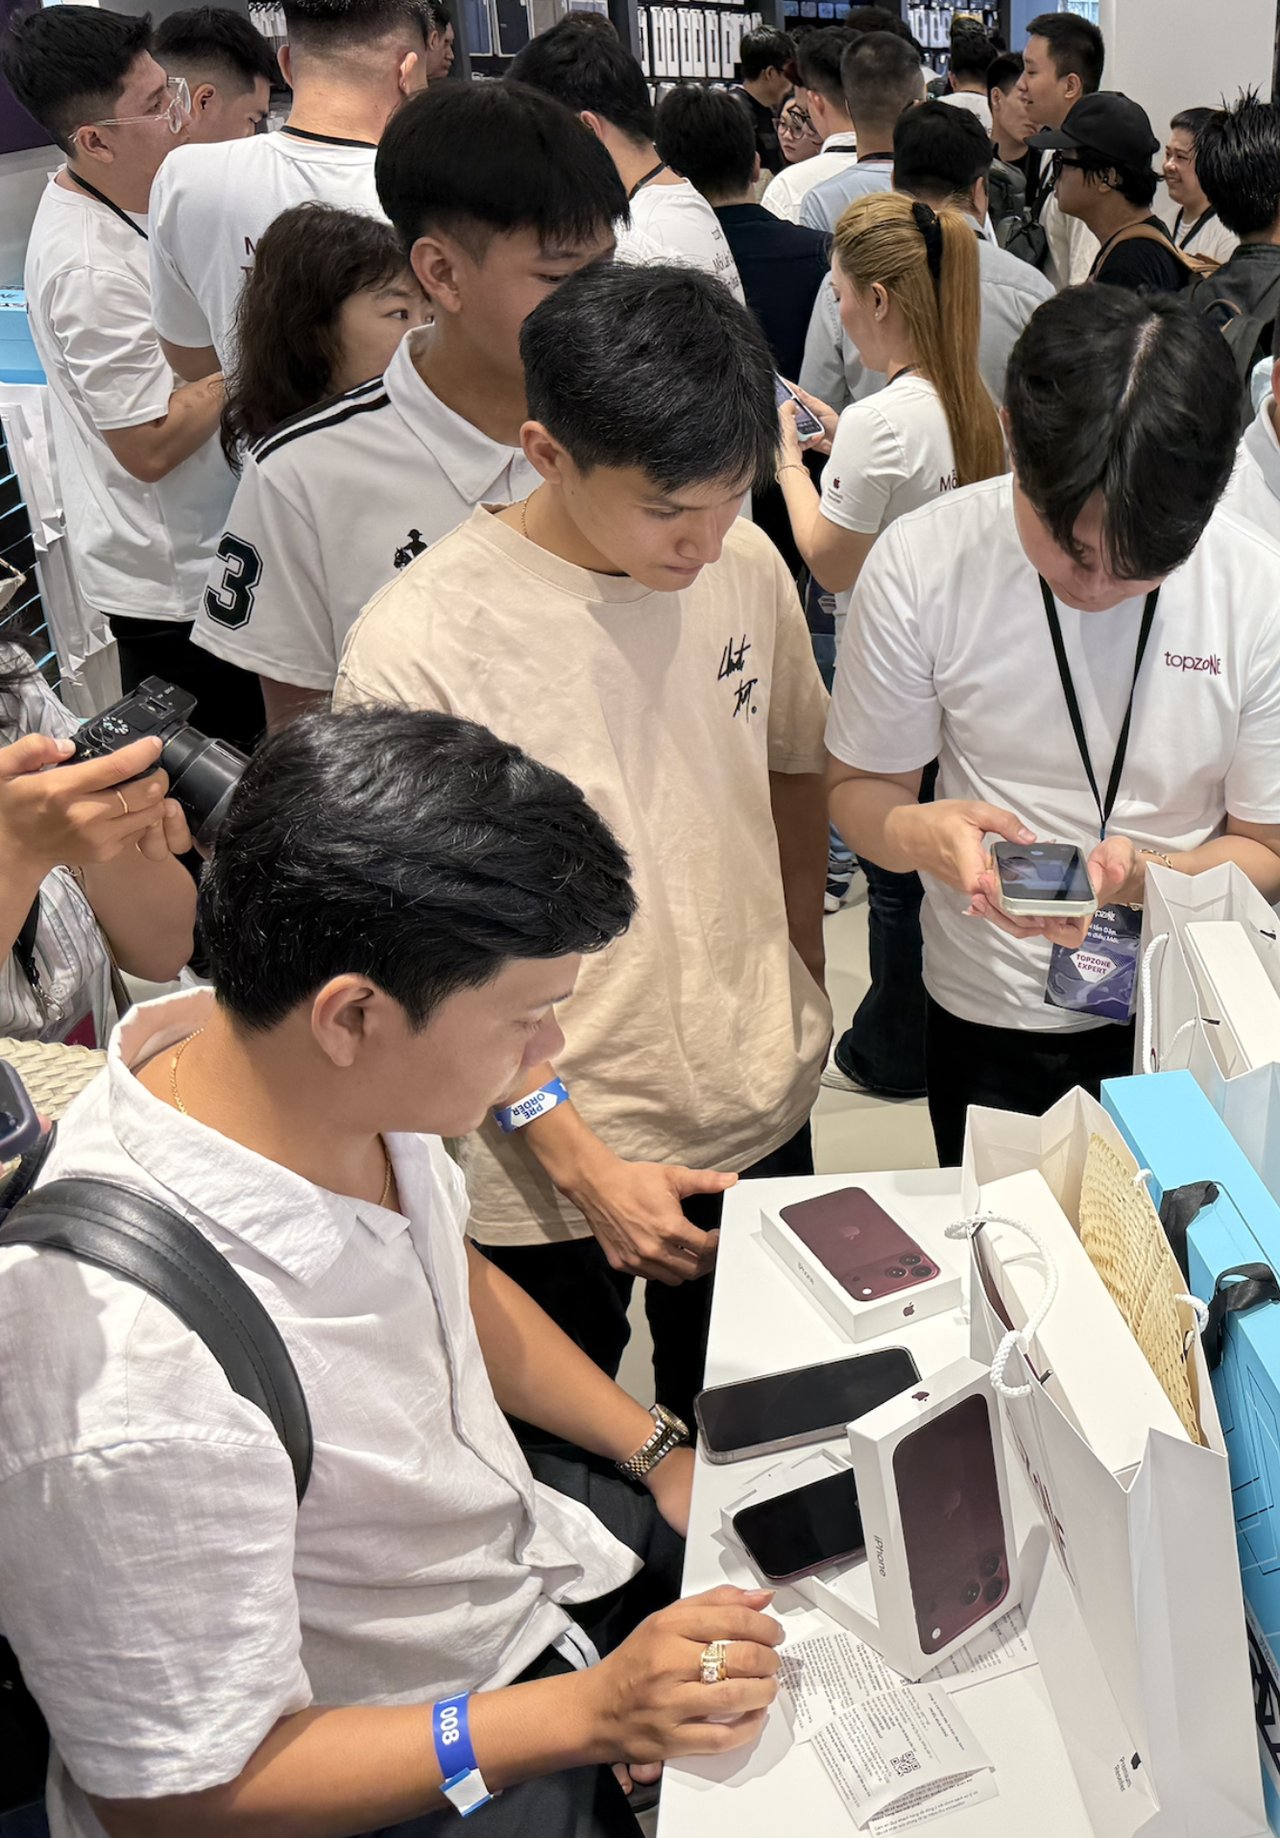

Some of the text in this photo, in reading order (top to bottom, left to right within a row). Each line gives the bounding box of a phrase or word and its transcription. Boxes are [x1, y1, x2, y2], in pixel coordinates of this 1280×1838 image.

[203, 531, 263, 630] 3
[1076, 953, 1111, 968] TOPZONE
[1077, 962, 1107, 974] EXPERT
[512, 1093, 545, 1116] ORDER
[524, 1104, 544, 1119] PRE
[874, 1534, 886, 1578] iPhone
[440, 1706, 460, 1745] 008
